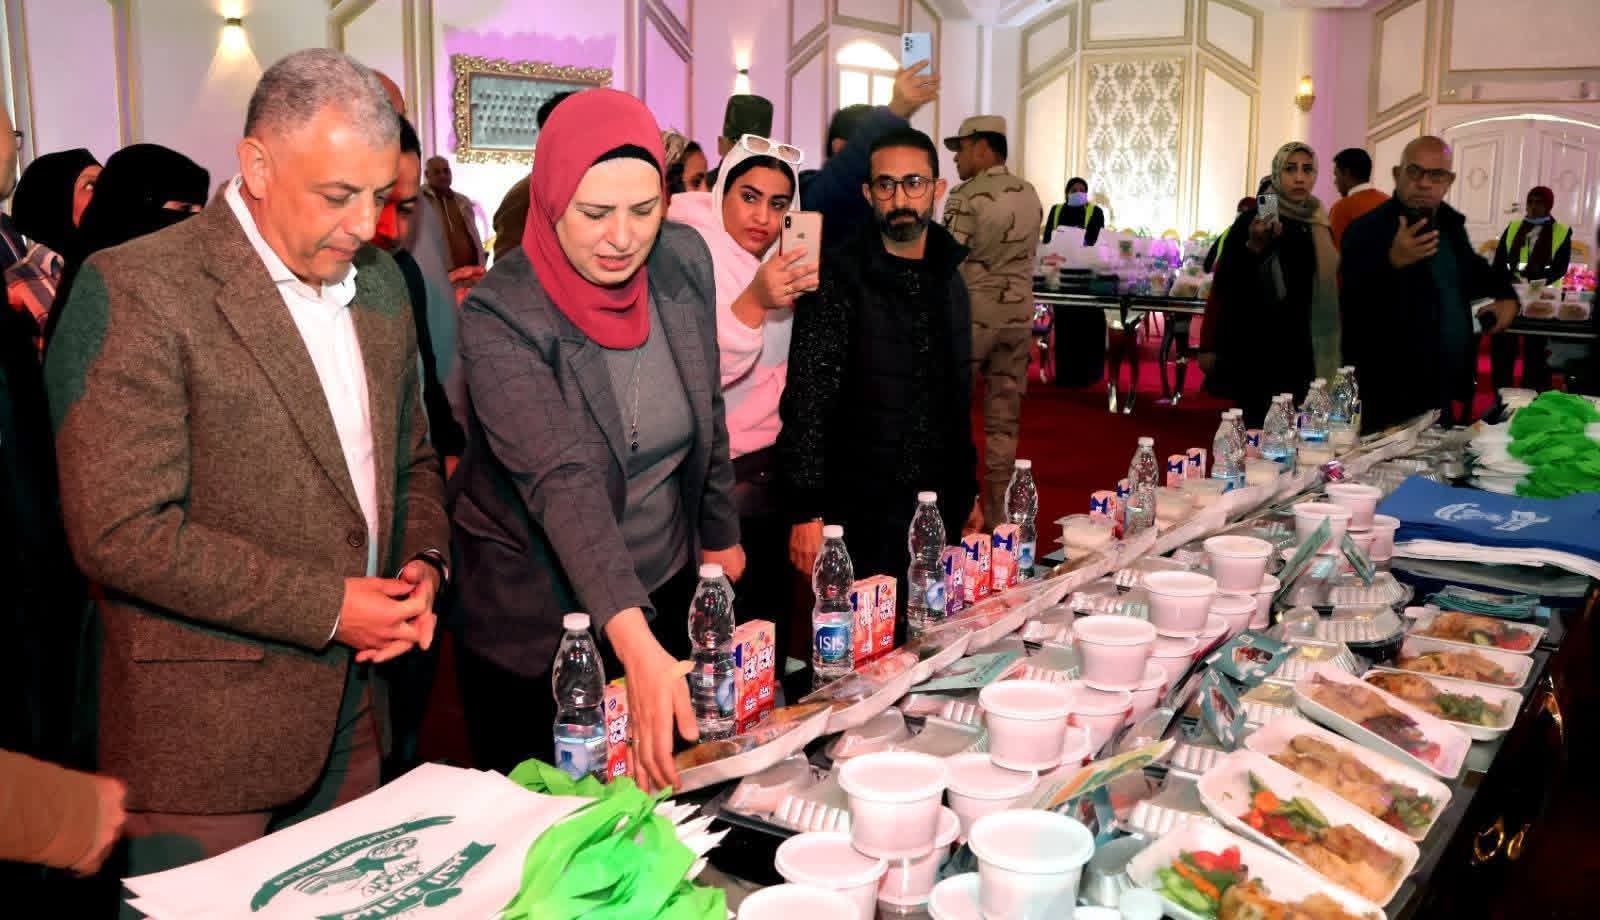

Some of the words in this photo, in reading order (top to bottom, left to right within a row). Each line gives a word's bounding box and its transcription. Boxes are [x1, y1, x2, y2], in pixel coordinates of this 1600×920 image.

[819, 635, 845, 651] ISIS
[342, 886, 419, 920] مبادرة
[425, 854, 469, 884] الخير
